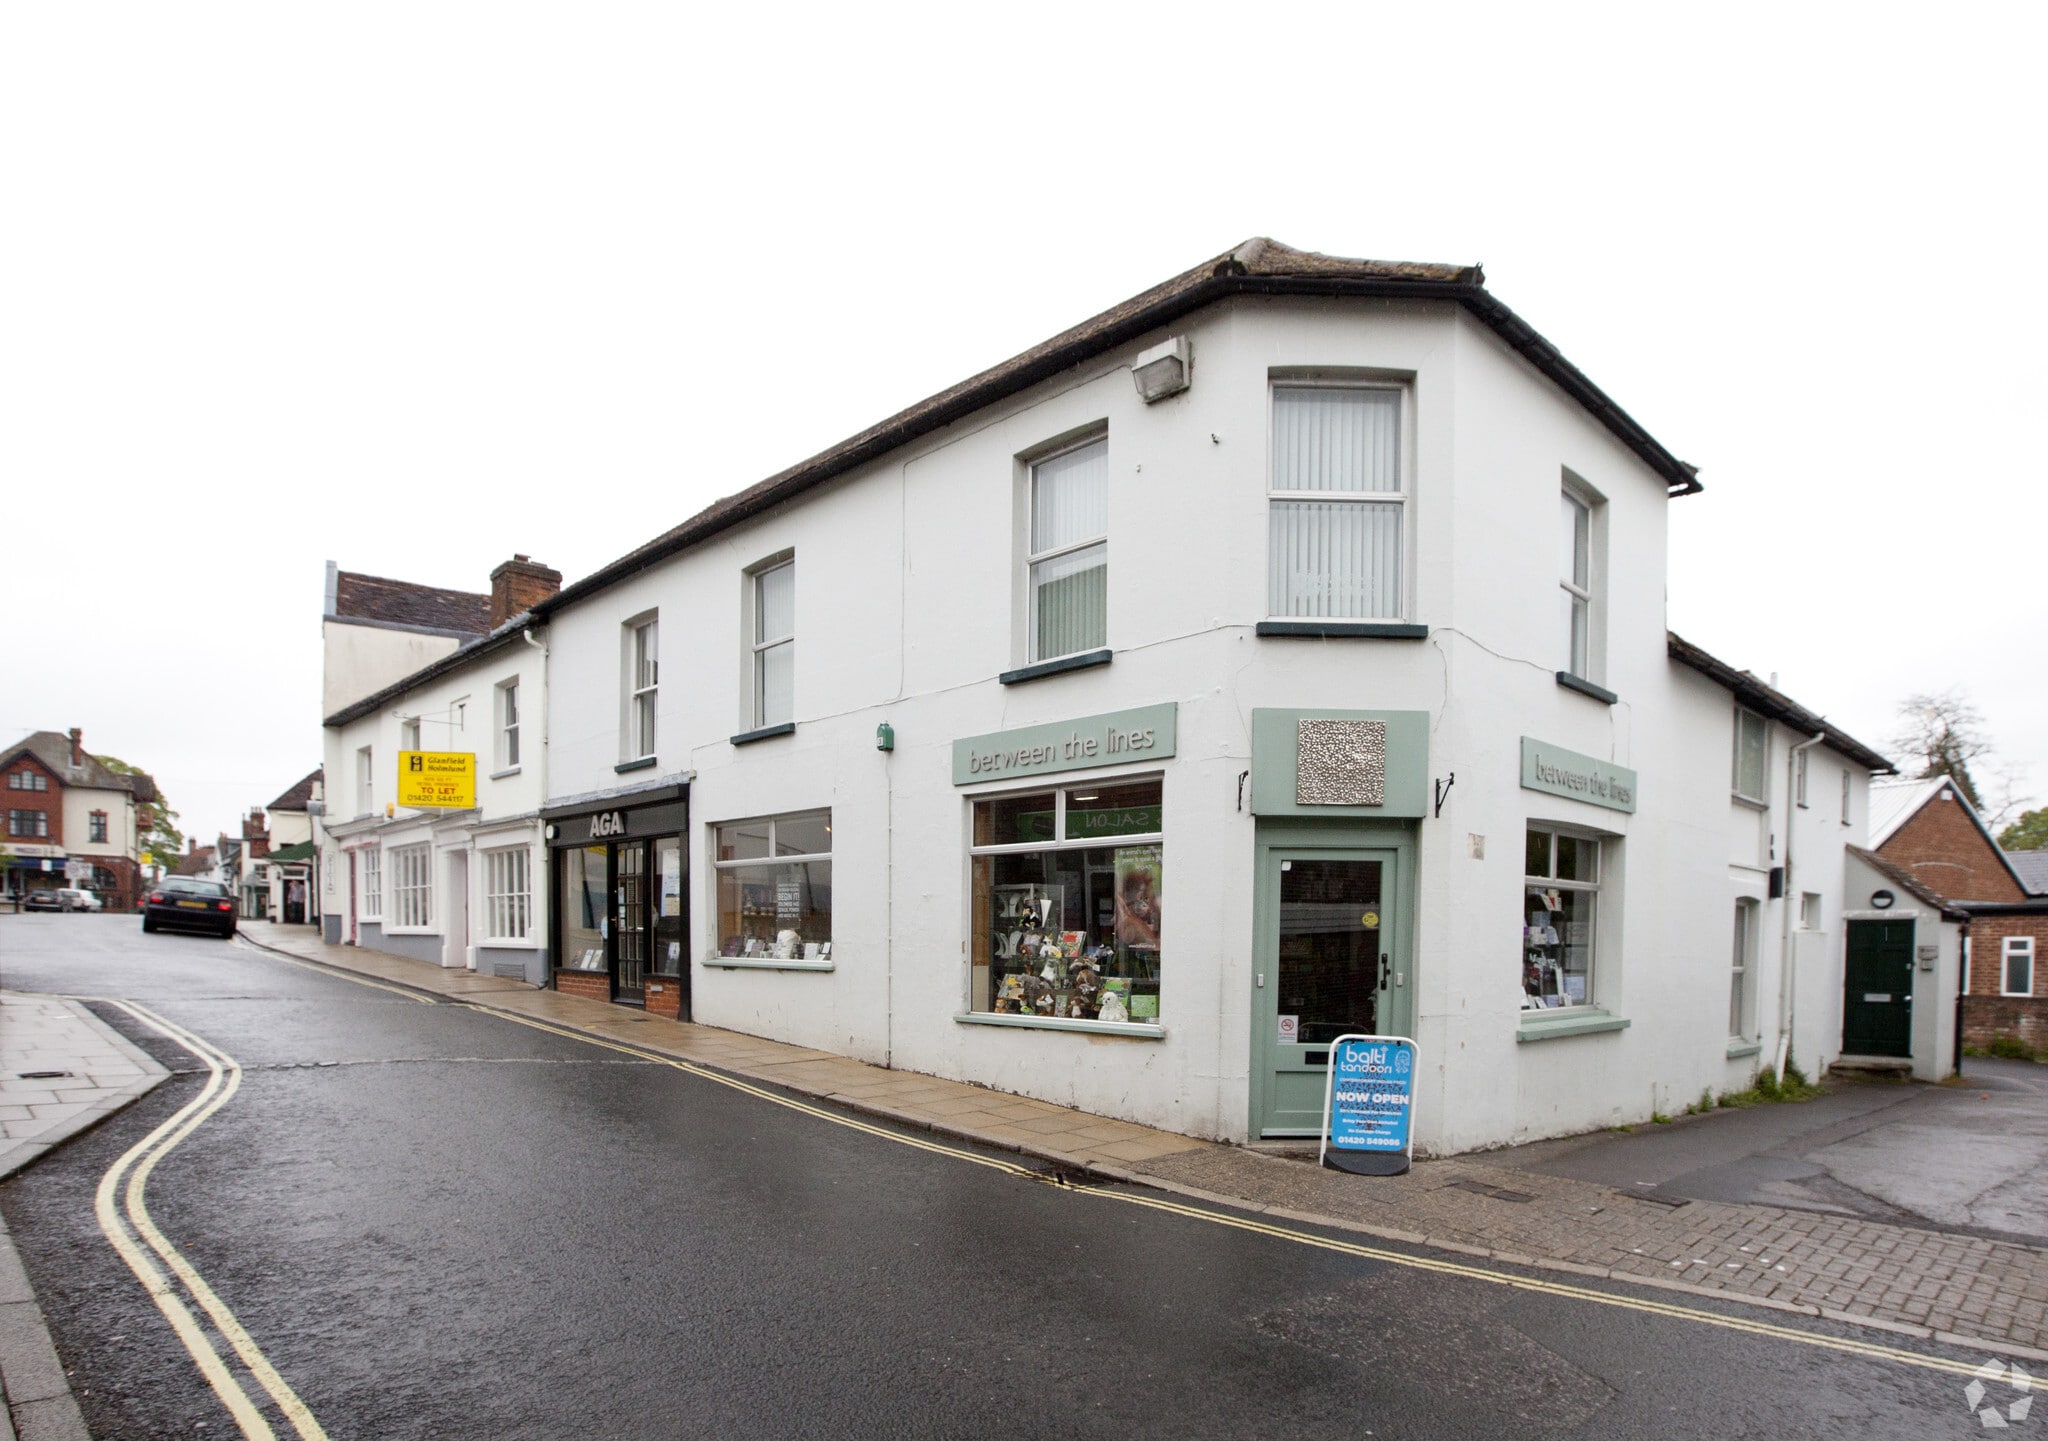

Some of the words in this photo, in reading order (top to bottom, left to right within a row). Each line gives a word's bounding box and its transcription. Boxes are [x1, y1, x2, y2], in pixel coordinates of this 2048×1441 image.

[968, 743, 1056, 774] between
[1064, 731, 1098, 760] the
[1106, 725, 1156, 754] lines
[421, 786, 434, 794] TO
[438, 787, 456, 795] LET
[589, 811, 625, 838] AGA
[1345, 1045, 1389, 1065] balti
[1340, 1061, 1392, 1074] tandoori
[1336, 1091, 1370, 1102] NOW
[1372, 1093, 1409, 1105] OPEN
